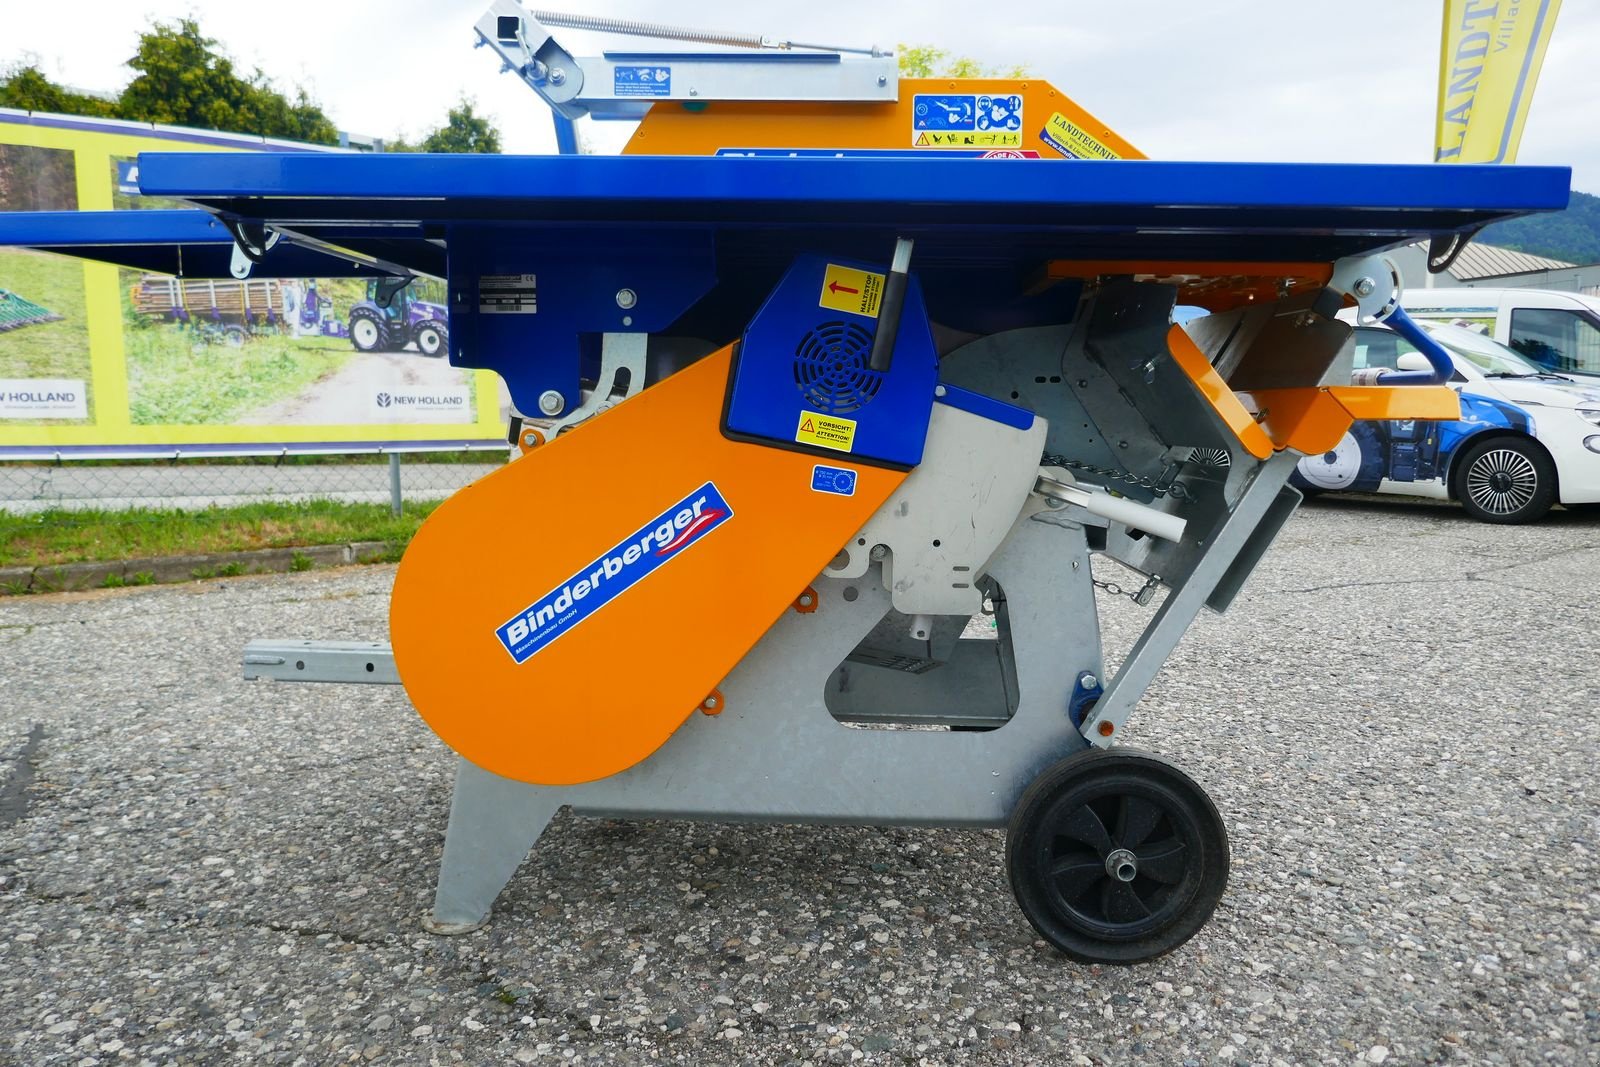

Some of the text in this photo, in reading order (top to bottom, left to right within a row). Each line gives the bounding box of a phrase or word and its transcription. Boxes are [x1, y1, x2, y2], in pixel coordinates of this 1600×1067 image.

[860, 274, 872, 313] HALT/STOP
[8, 392, 76, 402] HOLLAND
[394, 396, 463, 405] NEW HOLLAND
[818, 420, 852, 432] VORSICHT!
[816, 430, 850, 441] ATTENTION!
[506, 496, 706, 647] Binderberger
[515, 608, 578, 655] Maschinenbau GmbH
